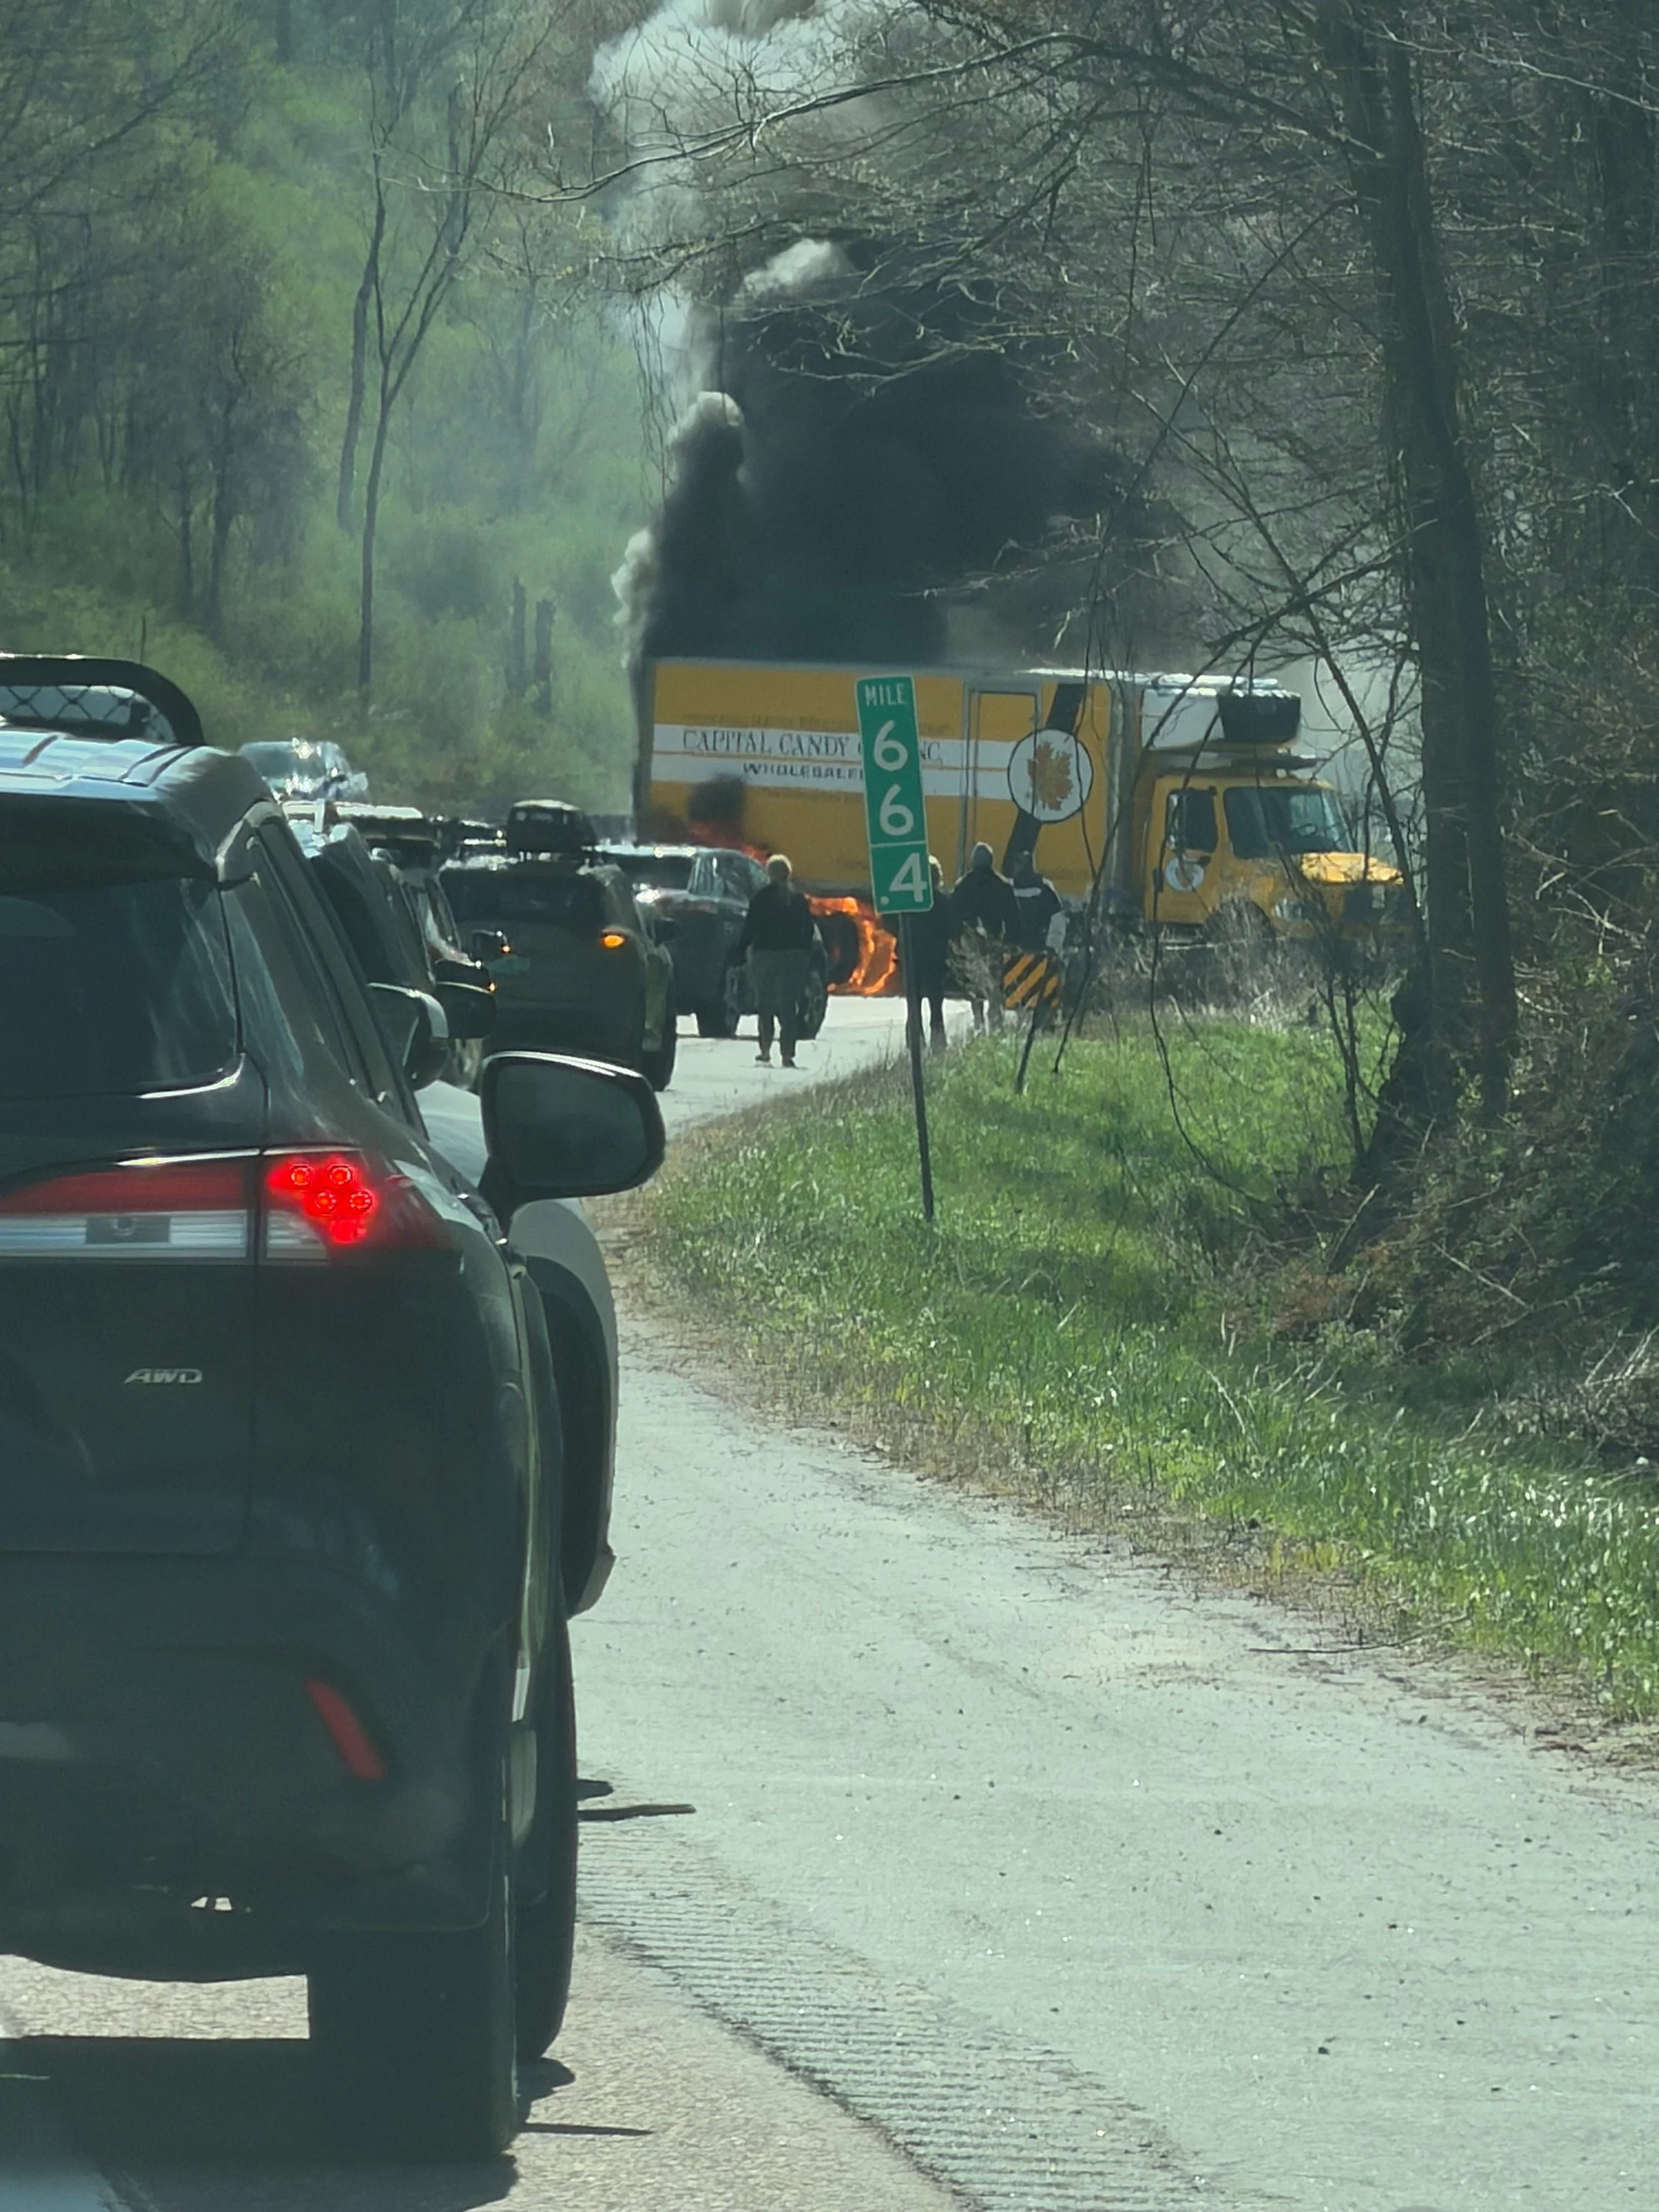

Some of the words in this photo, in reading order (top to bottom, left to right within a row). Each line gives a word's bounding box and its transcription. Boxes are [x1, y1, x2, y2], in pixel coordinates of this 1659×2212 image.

[864, 683, 906, 707] MILE
[682, 729, 772, 754] CAPITAL
[779, 733, 849, 757] CANDY
[743, 762, 863, 781] WHOLESALE
[124, 1368, 202, 1384] AWD
